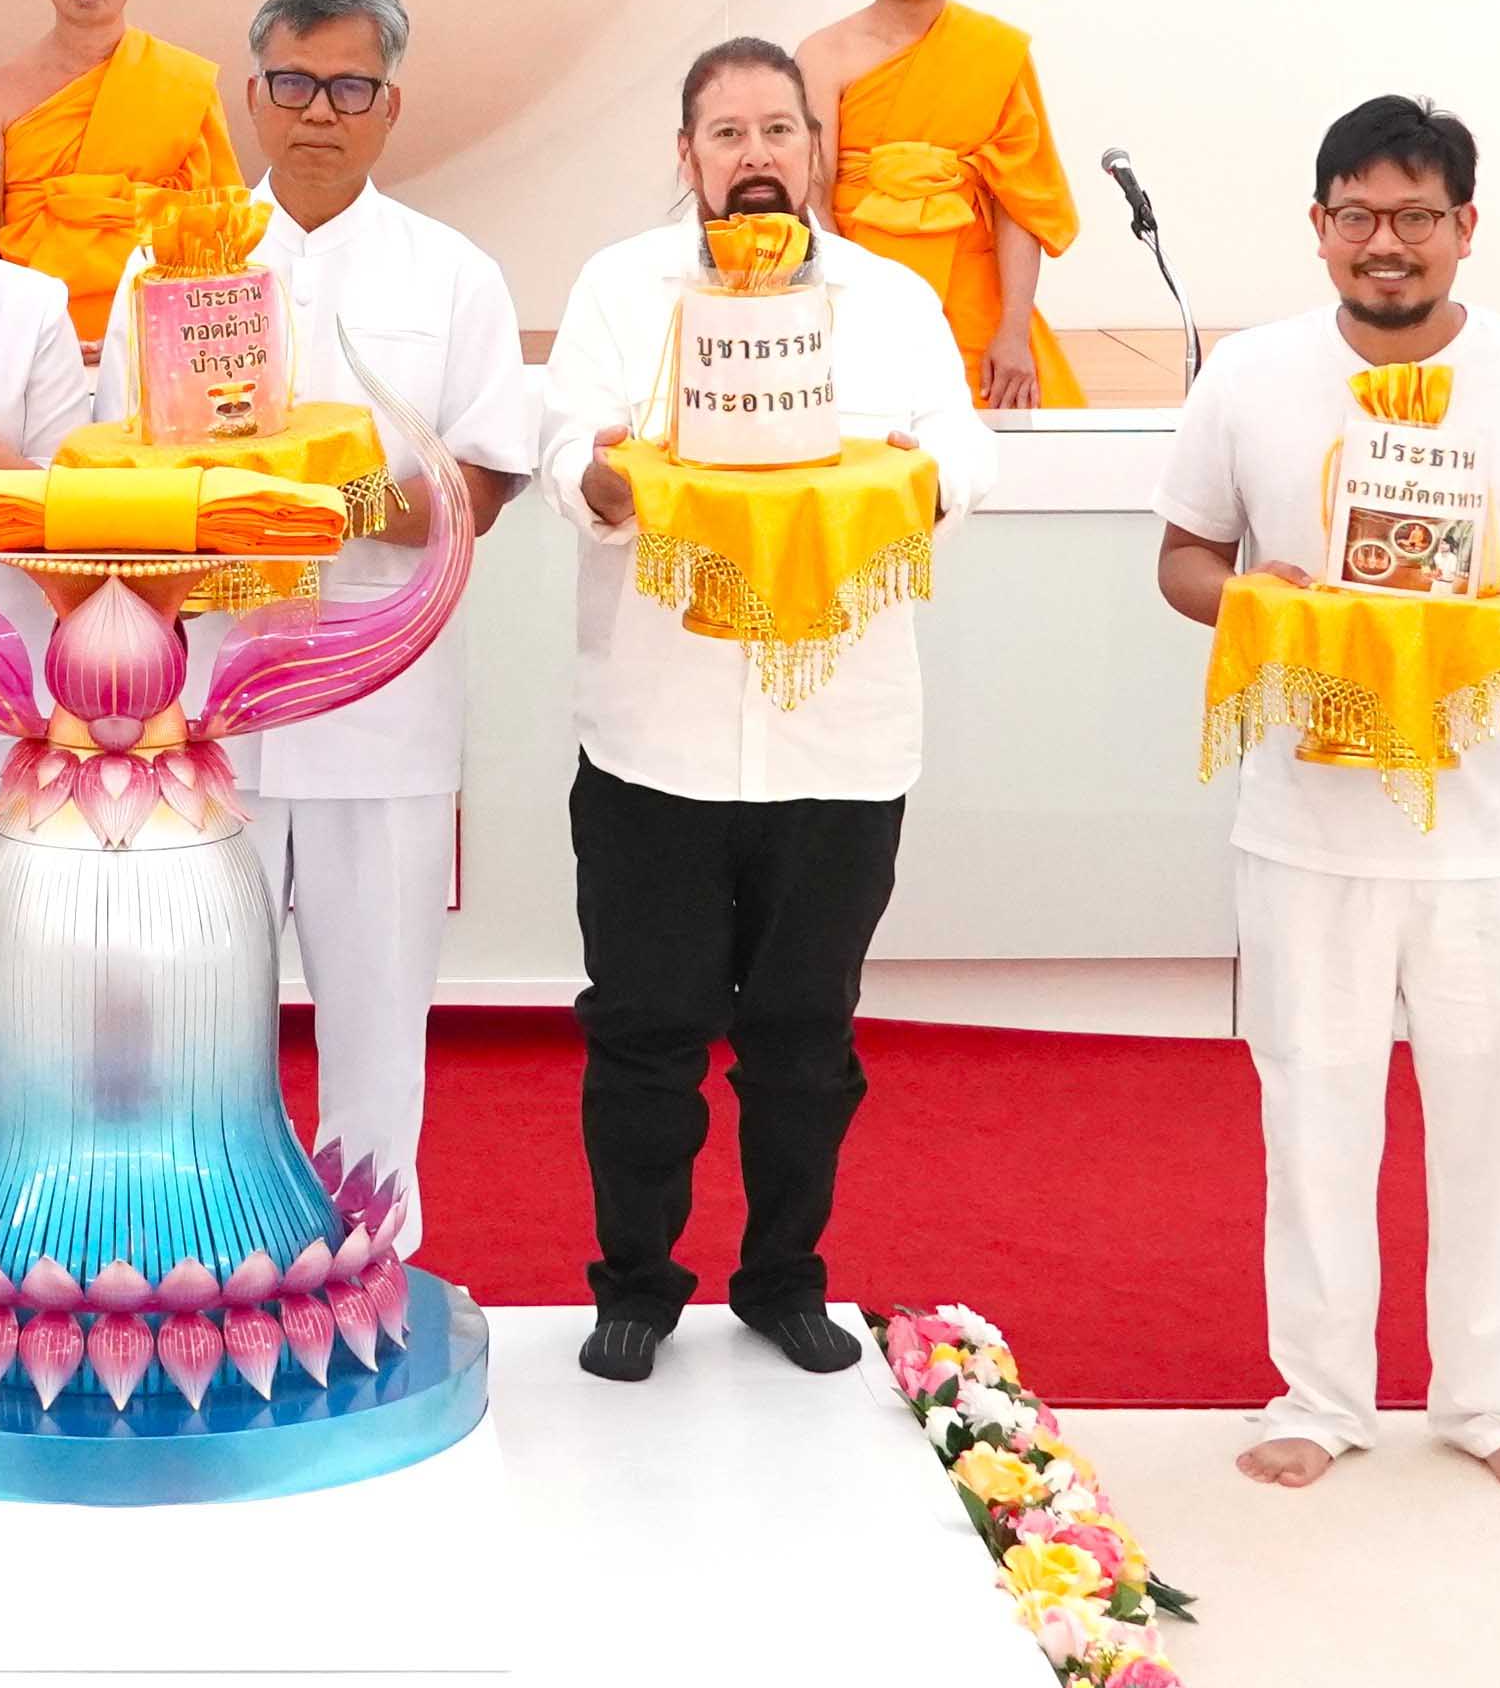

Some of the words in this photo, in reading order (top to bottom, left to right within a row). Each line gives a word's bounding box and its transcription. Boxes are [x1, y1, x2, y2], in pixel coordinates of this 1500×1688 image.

[185, 285, 263, 309] ประธาน
[180, 312, 270, 342] ทอดผ้าป่า
[190, 344, 268, 379] บำรุงวัด
[696, 328, 823, 367] บูชาธรรม
[683, 367, 834, 413] พระอาจารย์
[1369, 431, 1477, 470] ประธาน
[1346, 478, 1484, 509] ถวายภัตตาหาร
